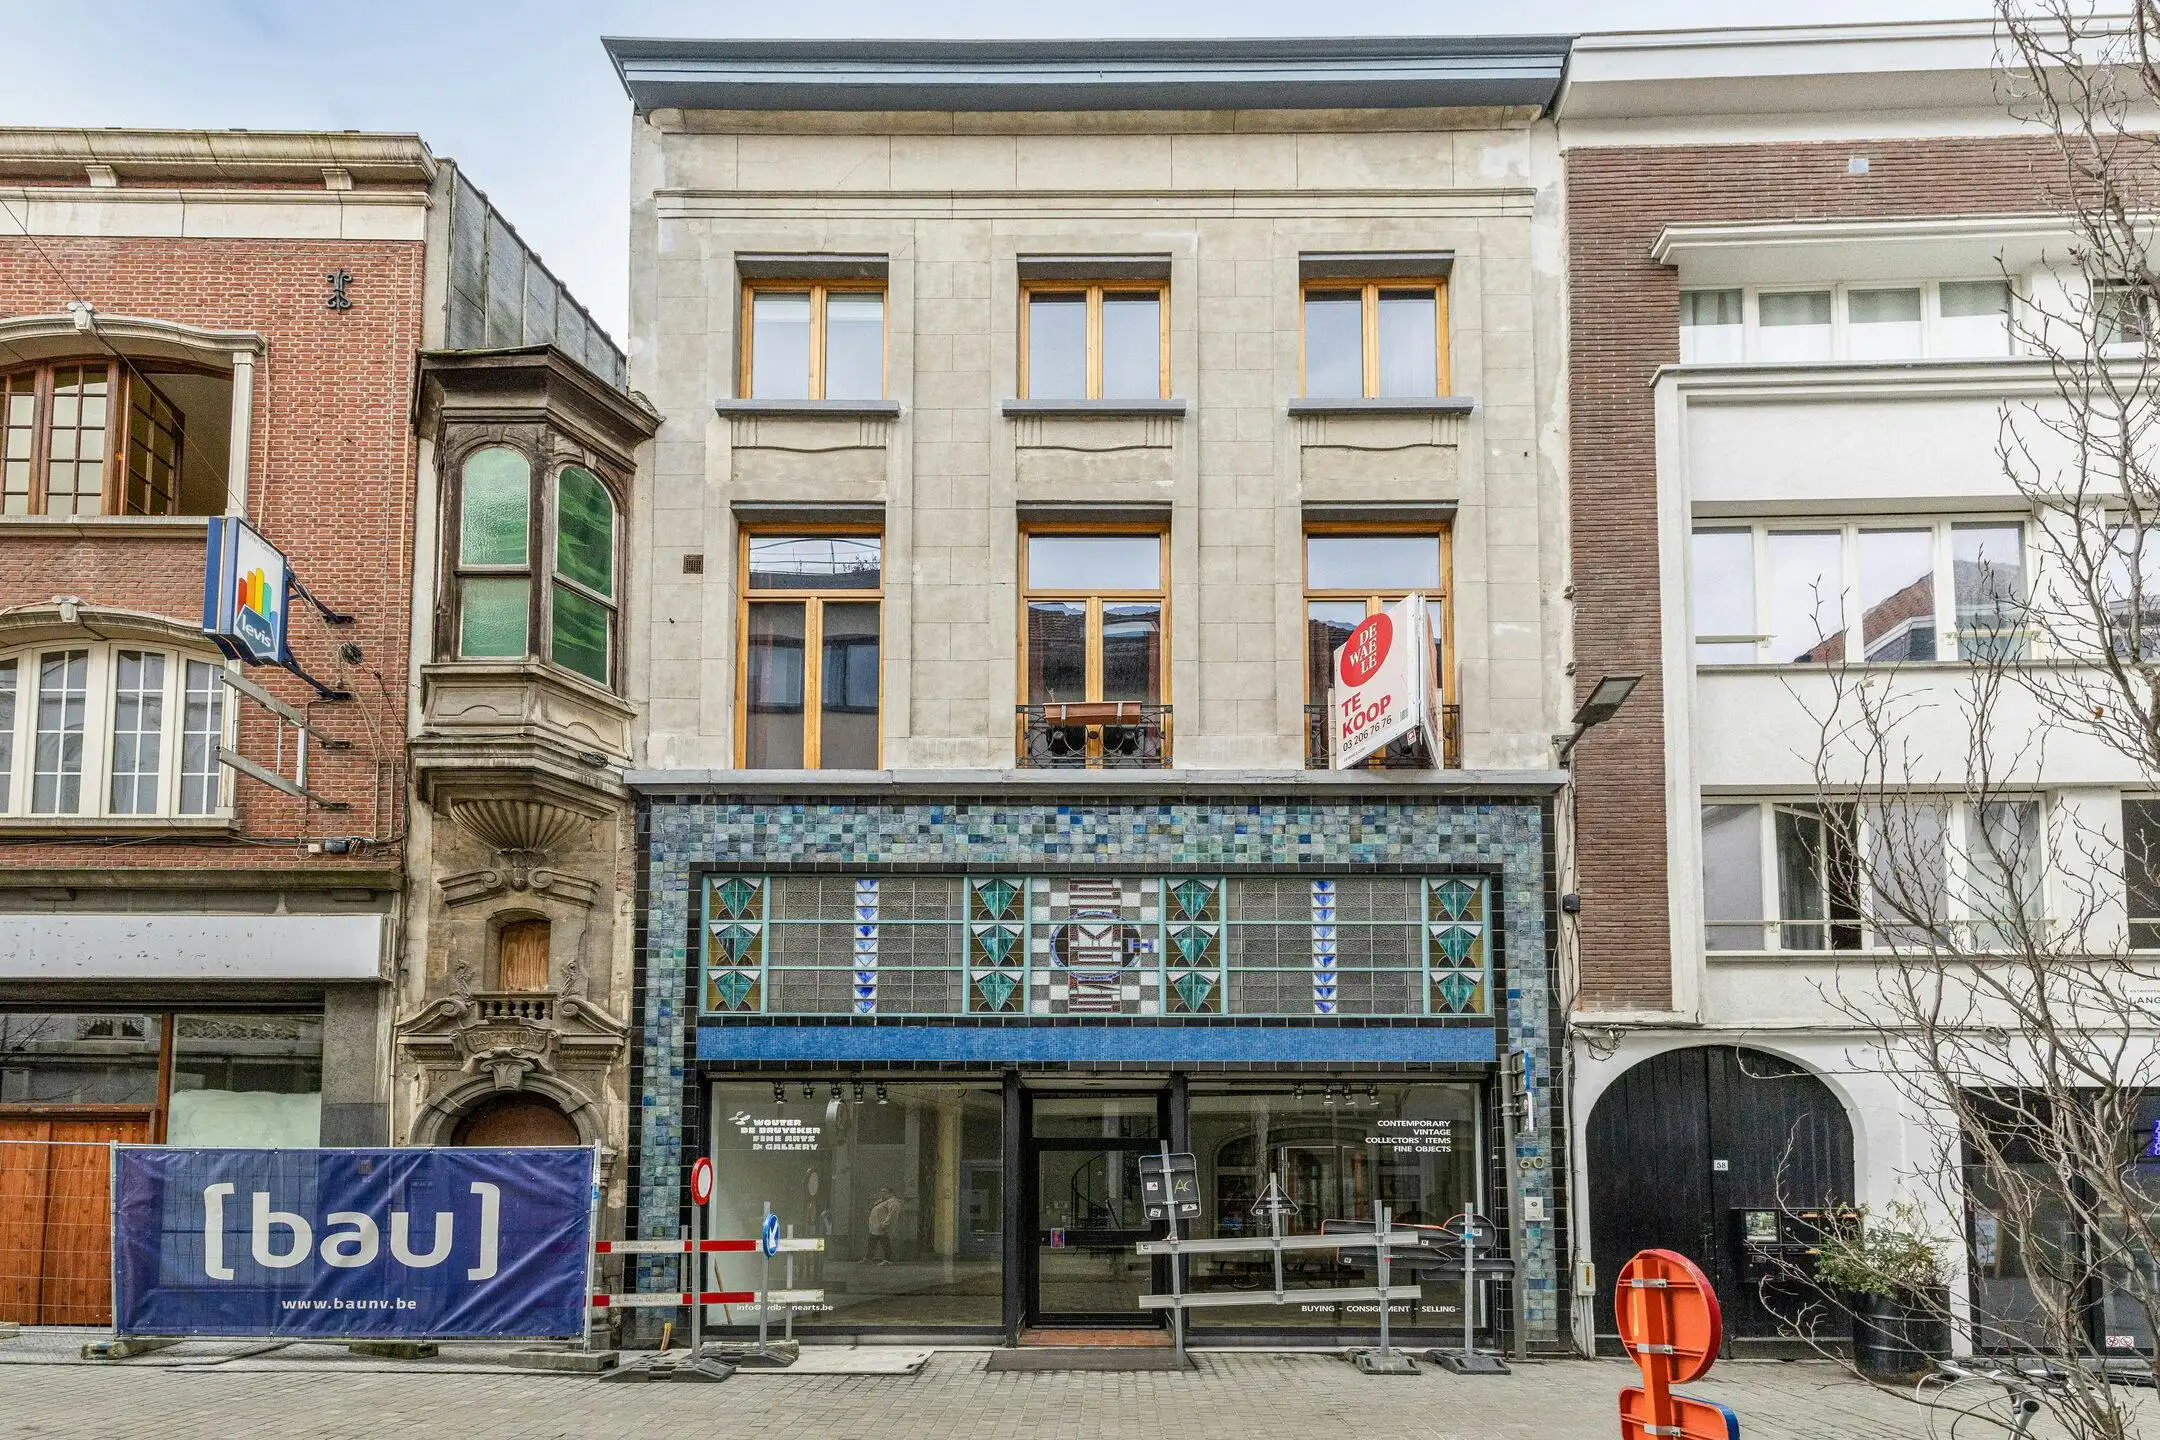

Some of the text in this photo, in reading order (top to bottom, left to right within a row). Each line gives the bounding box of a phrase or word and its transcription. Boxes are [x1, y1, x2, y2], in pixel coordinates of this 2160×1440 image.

[241, 614, 271, 648] levis
[1359, 623, 1377, 646] DE
[1349, 638, 1377, 667] WAE
[1361, 653, 1377, 675] LE
[1341, 692, 1362, 718] TE
[1342, 694, 1392, 739] KOOP
[1343, 715, 1392, 752] 03 206 76 76
[1520, 1157, 1544, 1169] 60
[1716, 1161, 1727, 1169] 58
[282, 1298, 417, 1310] www.baunv.be
